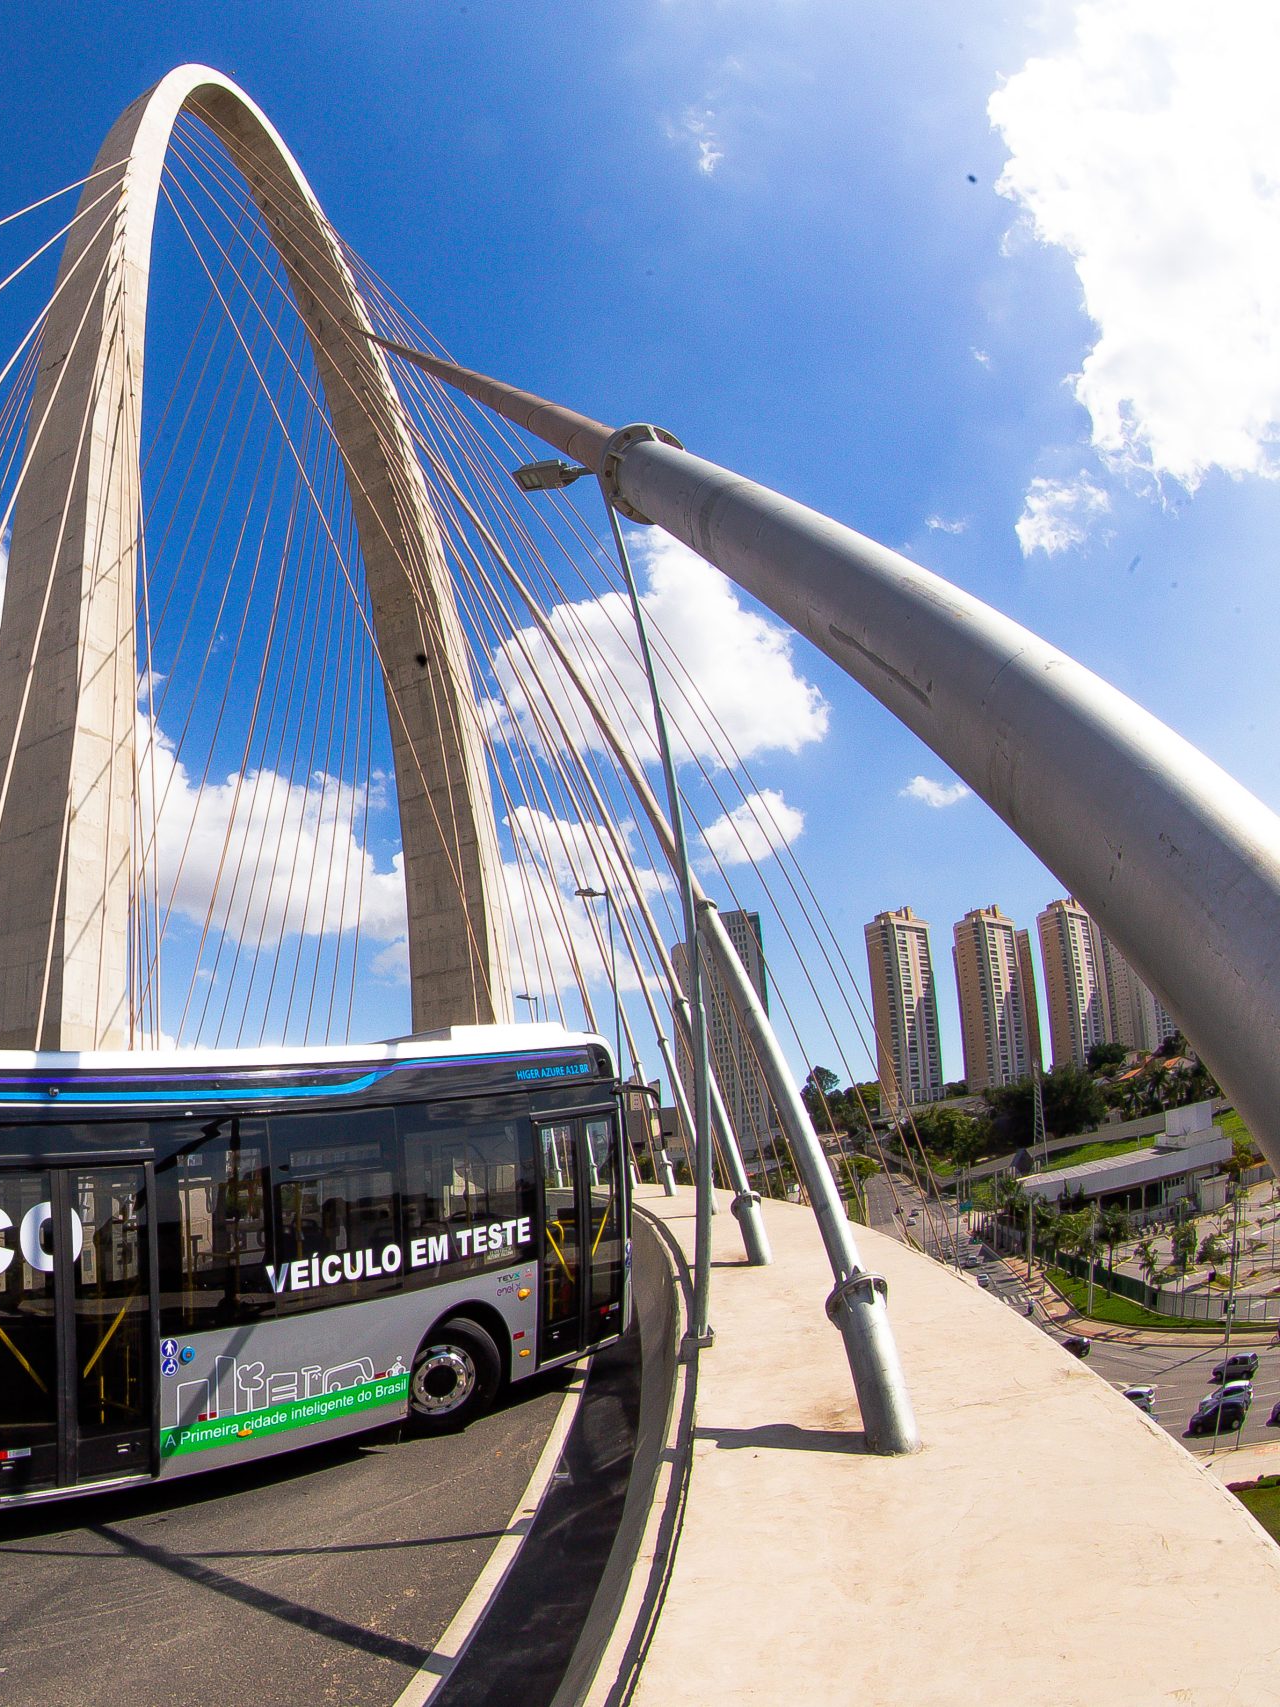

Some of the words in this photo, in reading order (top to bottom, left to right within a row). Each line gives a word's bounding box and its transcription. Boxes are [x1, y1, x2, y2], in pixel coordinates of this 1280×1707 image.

[516, 1068, 540, 1080] HIGER
[541, 1066, 565, 1077] AZURE
[565, 1064, 579, 1075] A12
[580, 1063, 589, 1073] BR
[265, 1244, 401, 1294] VEÍCULO
[410, 1233, 449, 1268] EM
[456, 1216, 531, 1257] TESTE
[164, 1434, 176, 1448] A
[180, 1423, 239, 1445] Primeira
[243, 1410, 287, 1431] cidade
[291, 1394, 354, 1419] inteligente
[357, 1389, 372, 1403] do
[375, 1378, 407, 1398] Brasil
